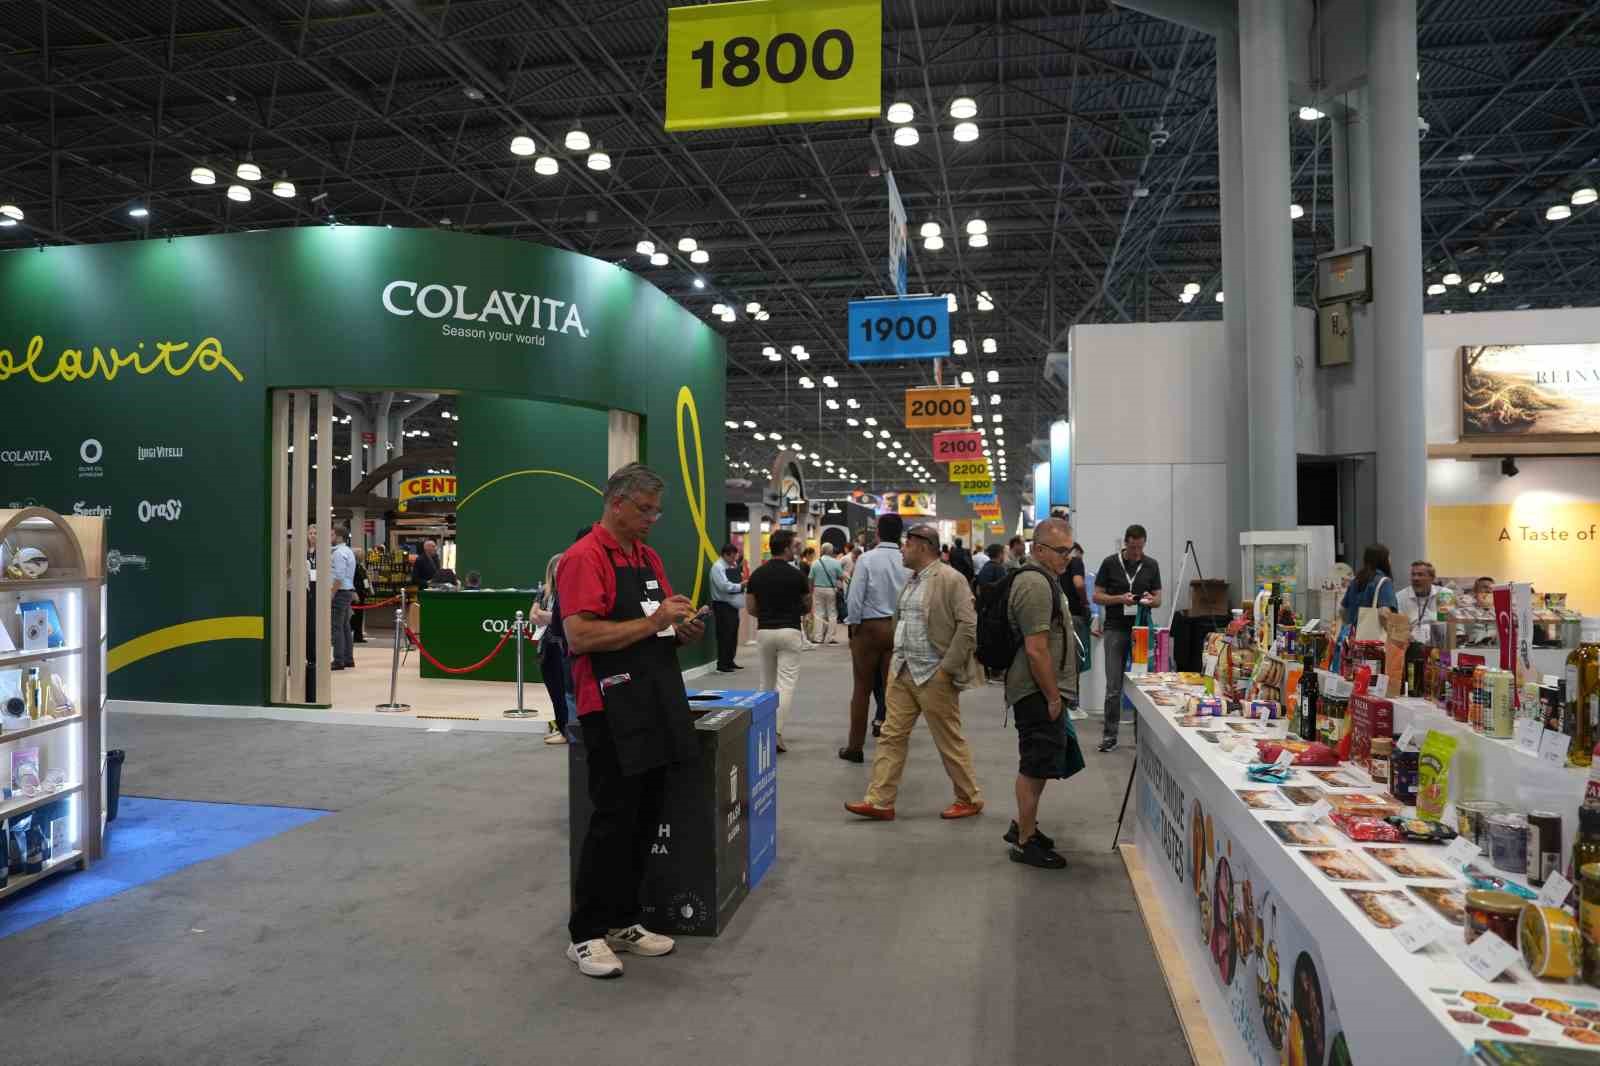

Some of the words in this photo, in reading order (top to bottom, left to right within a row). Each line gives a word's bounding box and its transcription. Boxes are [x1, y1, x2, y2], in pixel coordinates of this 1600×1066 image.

[691, 29, 854, 89] 1800
[382, 280, 588, 338] COLAVITA
[442, 324, 486, 339] Season
[489, 330, 513, 343] your
[516, 333, 545, 346] world
[861, 315, 937, 342] 1900
[911, 400, 966, 416] 2000
[0, 450, 52, 462] COLAVITA
[939, 440, 977, 453] 2100
[953, 464, 985, 474] 2200
[1498, 527, 1511, 542] A
[1520, 526, 1569, 541] Taste
[1576, 525, 1596, 541] of
[1160, 808, 1184, 884] TASTES
